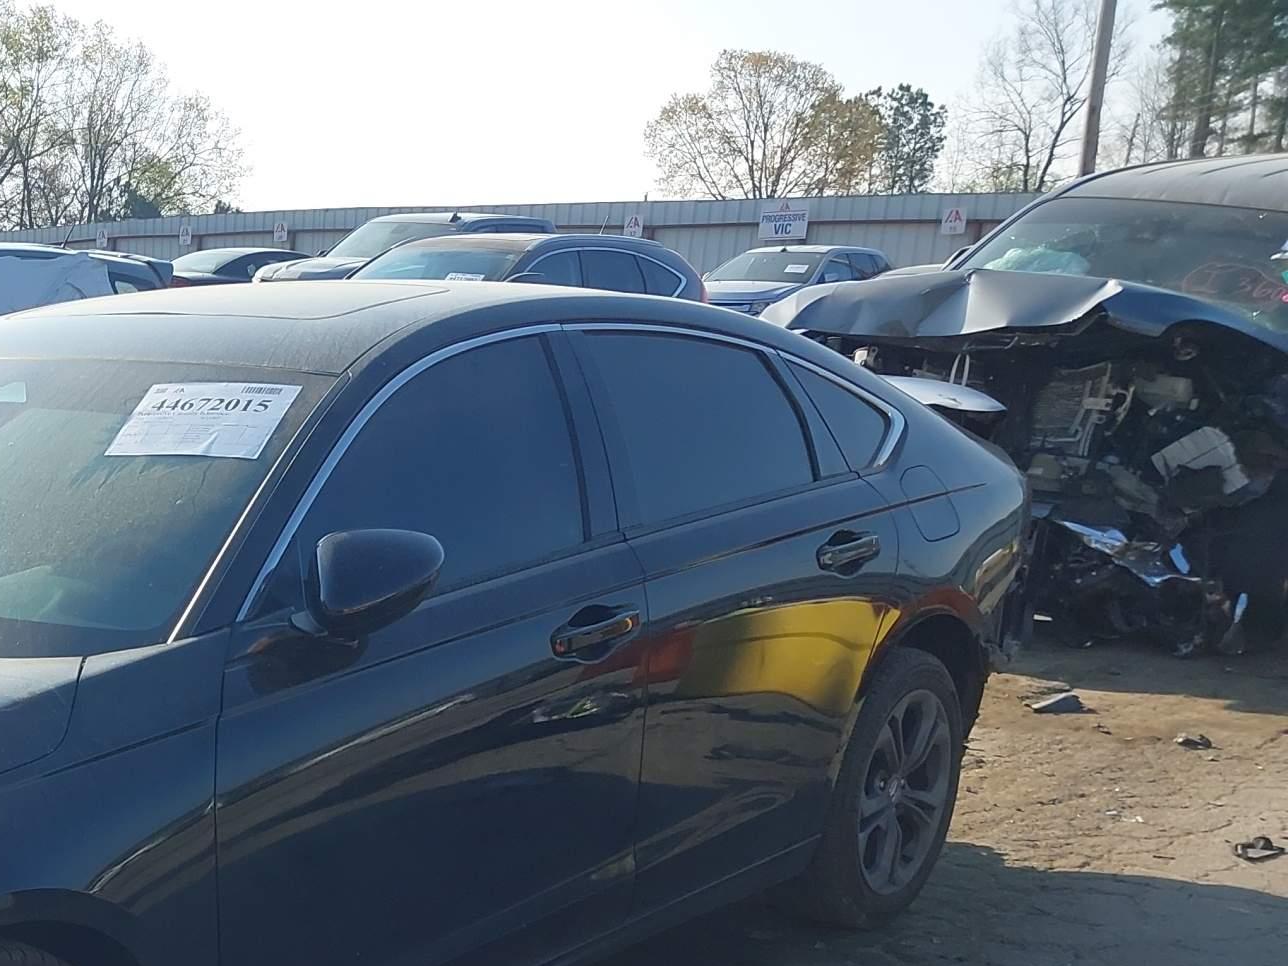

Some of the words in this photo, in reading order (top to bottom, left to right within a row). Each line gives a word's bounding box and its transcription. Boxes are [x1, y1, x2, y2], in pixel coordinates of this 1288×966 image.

[761, 212, 807, 223] PROGRESSIVE
[773, 223, 792, 235] VIC
[152, 398, 273, 413] 44672015
